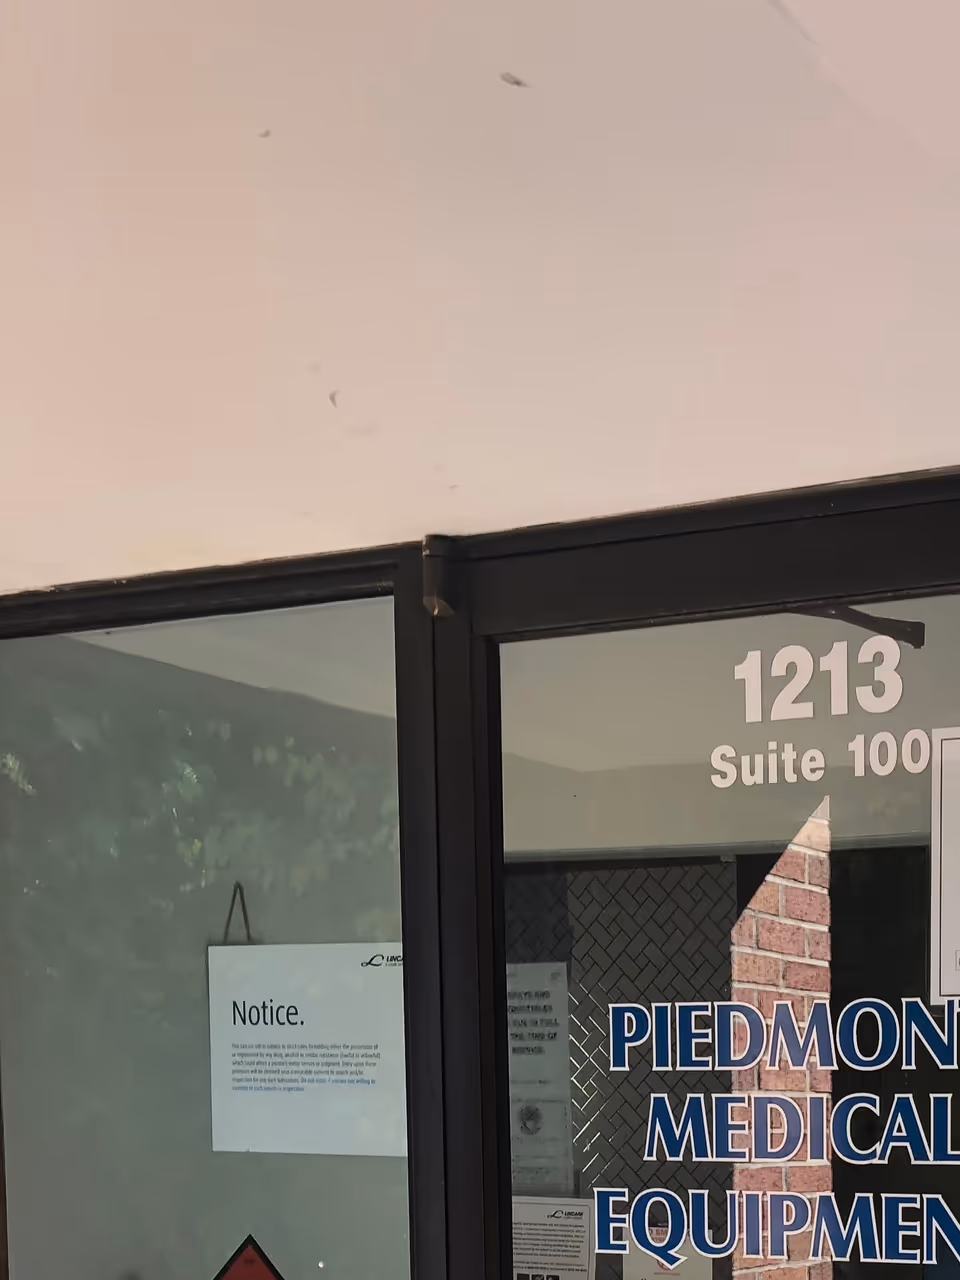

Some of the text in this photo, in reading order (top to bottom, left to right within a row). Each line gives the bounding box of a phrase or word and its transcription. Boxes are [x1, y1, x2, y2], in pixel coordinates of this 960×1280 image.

[734, 635, 903, 722] 1213
[711, 729, 930, 788] Suite 100
[232, 999, 304, 1026] Notice.
